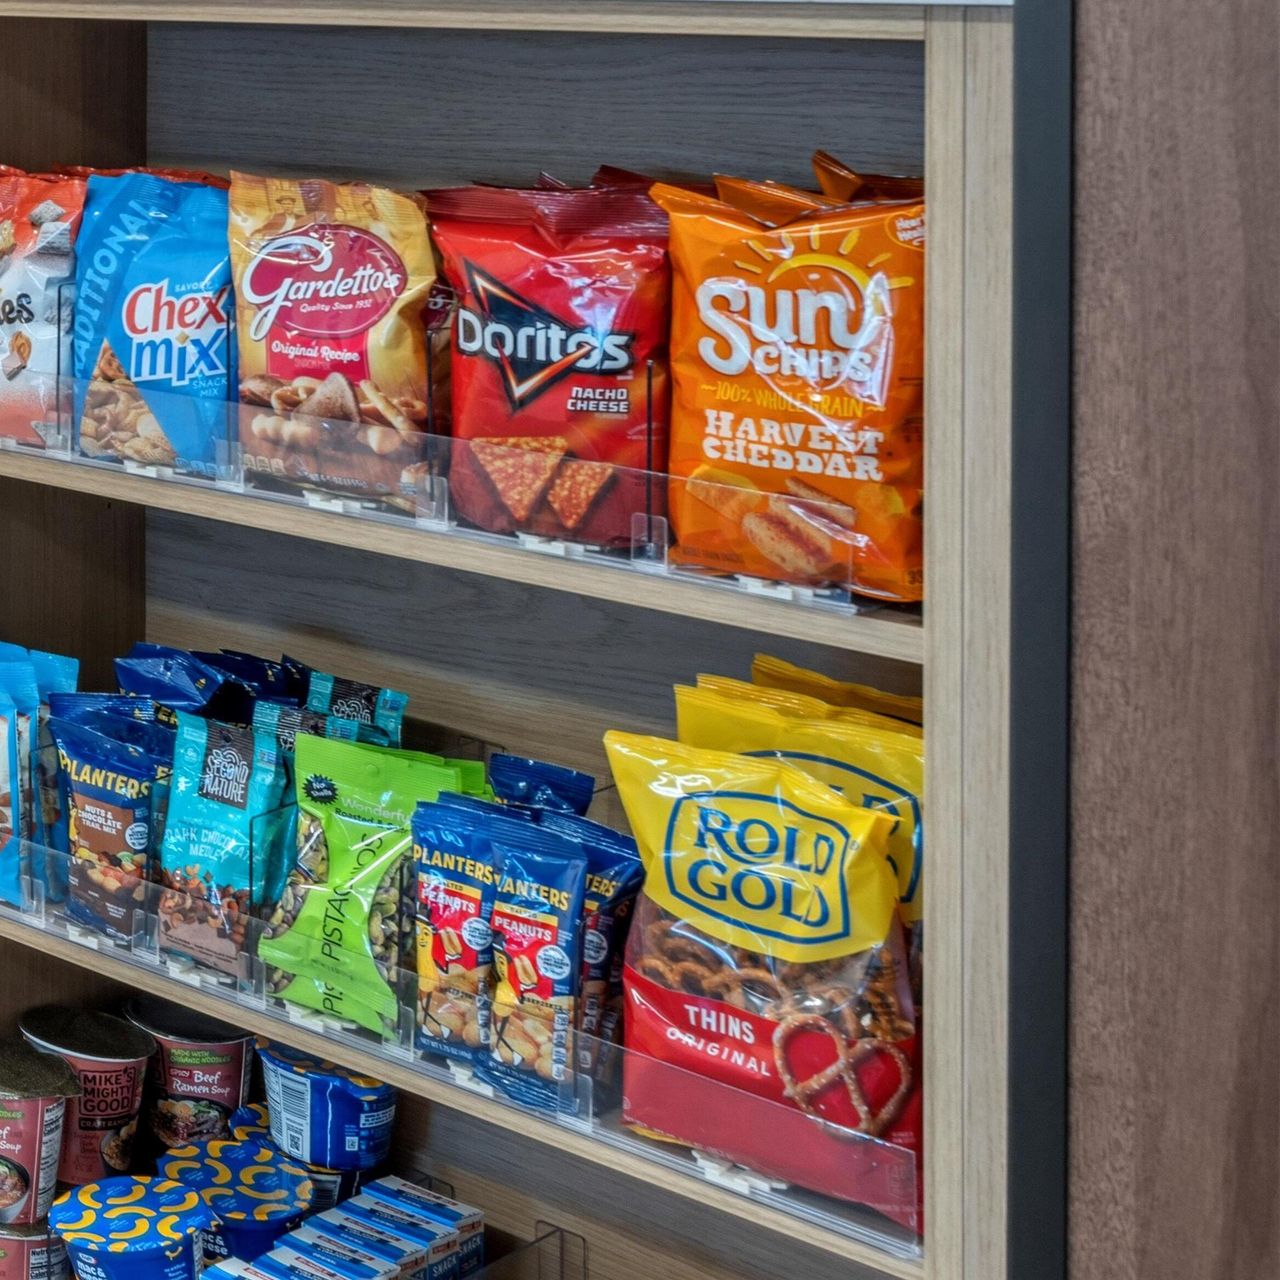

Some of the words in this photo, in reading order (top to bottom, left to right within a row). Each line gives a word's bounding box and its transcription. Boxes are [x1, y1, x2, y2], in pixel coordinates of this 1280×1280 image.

[242, 236, 402, 341] Gardetto's
[123, 282, 228, 336] Chex
[300, 301, 330, 313] Quality
[332, 300, 353, 311] Since
[456, 308, 632, 371] Doritos
[697, 275, 888, 377] Sun
[133, 328, 227, 383] mix
[271, 339, 319, 359] Original
[320, 346, 361, 363] Recipe
[753, 344, 873, 383] CHIPS
[192, 377, 228, 390] SNACK
[199, 388, 220, 397] MIX
[571, 386, 628, 401] NACHO
[567, 399, 629, 413] CHEESE
[715, 381, 751, 403] 100%
[754, 388, 805, 412] WHOLE
[809, 394, 864, 418] GRAIN
[704, 407, 884, 454] HARVEST
[702, 436, 884, 481] CHEDDAR
[58, 748, 151, 800] PLANTERS
[206, 753, 249, 786] SECOND
[203, 776, 245, 804] NATURE
[78, 809, 122, 830] CHOCOLATE
[85, 804, 106, 817] NUTS
[82, 819, 102, 832] TRAIL
[102, 825, 117, 835] MIX
[694, 805, 835, 877] ROLD
[413, 843, 495, 883] PLANTERS
[687, 857, 831, 929] GOLD
[494, 915, 552, 941] PEANUTS
[685, 1005, 755, 1045] THINS
[666, 1026, 772, 1077] ORIGINAL
[82, 1071, 134, 1086] MIKE'S
[172, 1077, 210, 1093] Ramen
[211, 1086, 230, 1097] Soup
[192, 1070, 222, 1084] Beef
[82, 1084, 131, 1098] MIGHTY
[83, 1096, 131, 1113] GOOD
[0, 1140, 22, 1153] Soup
[77, 1260, 97, 1276] mac
[97, 1267, 107, 1278] &
